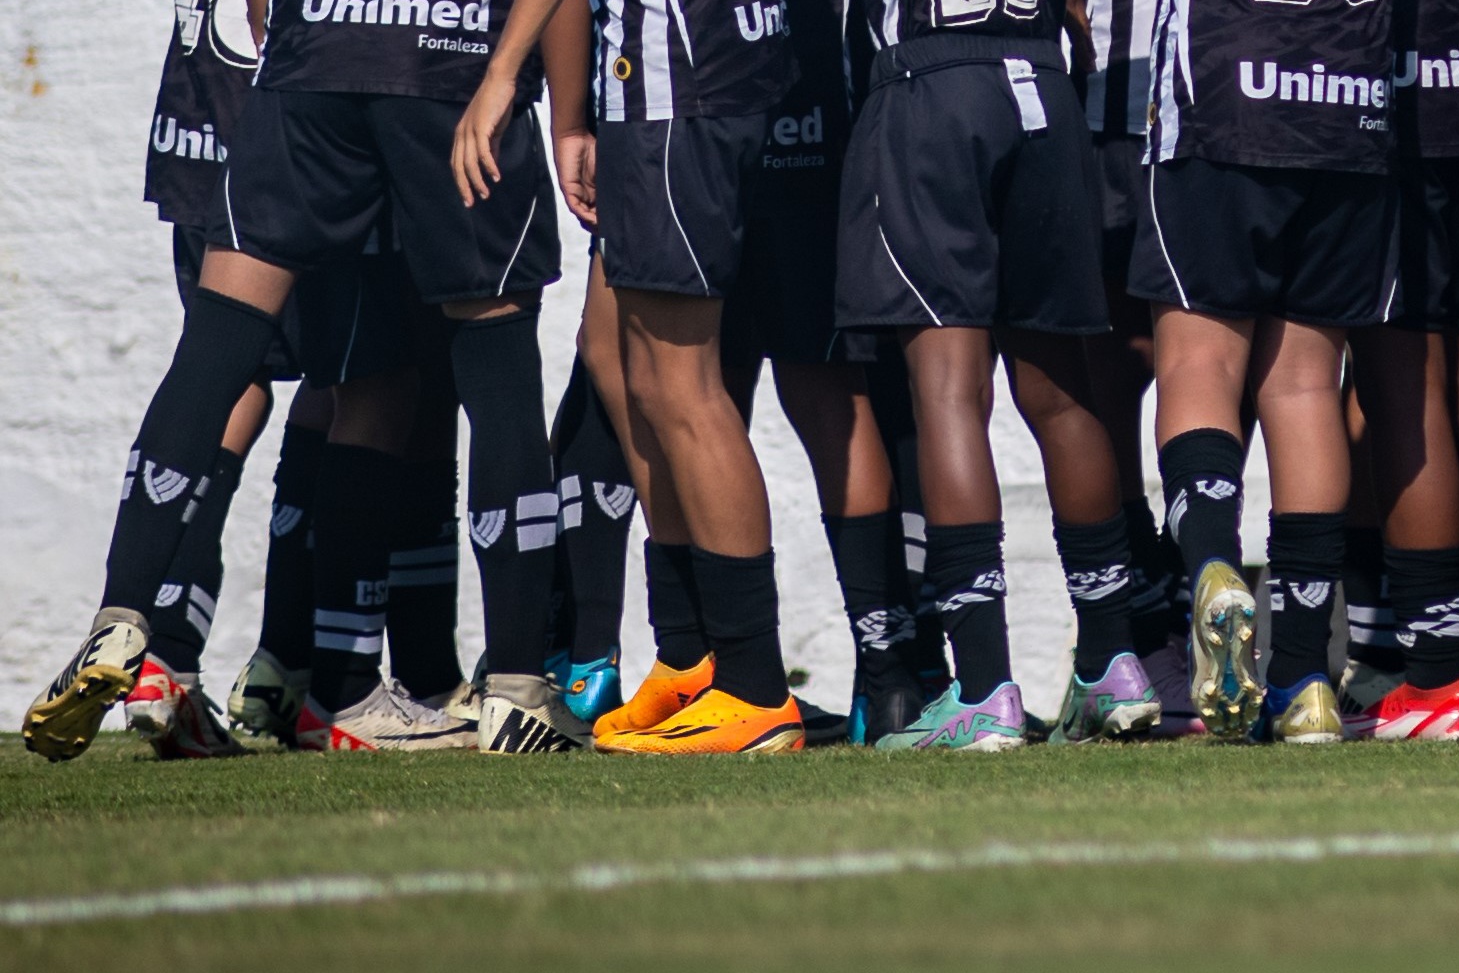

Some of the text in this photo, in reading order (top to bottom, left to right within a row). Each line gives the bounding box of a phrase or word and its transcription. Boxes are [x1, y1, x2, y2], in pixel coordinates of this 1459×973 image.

[418, 34, 489, 55] Fortaleza
[1240, 60, 1392, 109] Unime
[766, 105, 824, 146] ed
[763, 155, 825, 169] Fortaleza
